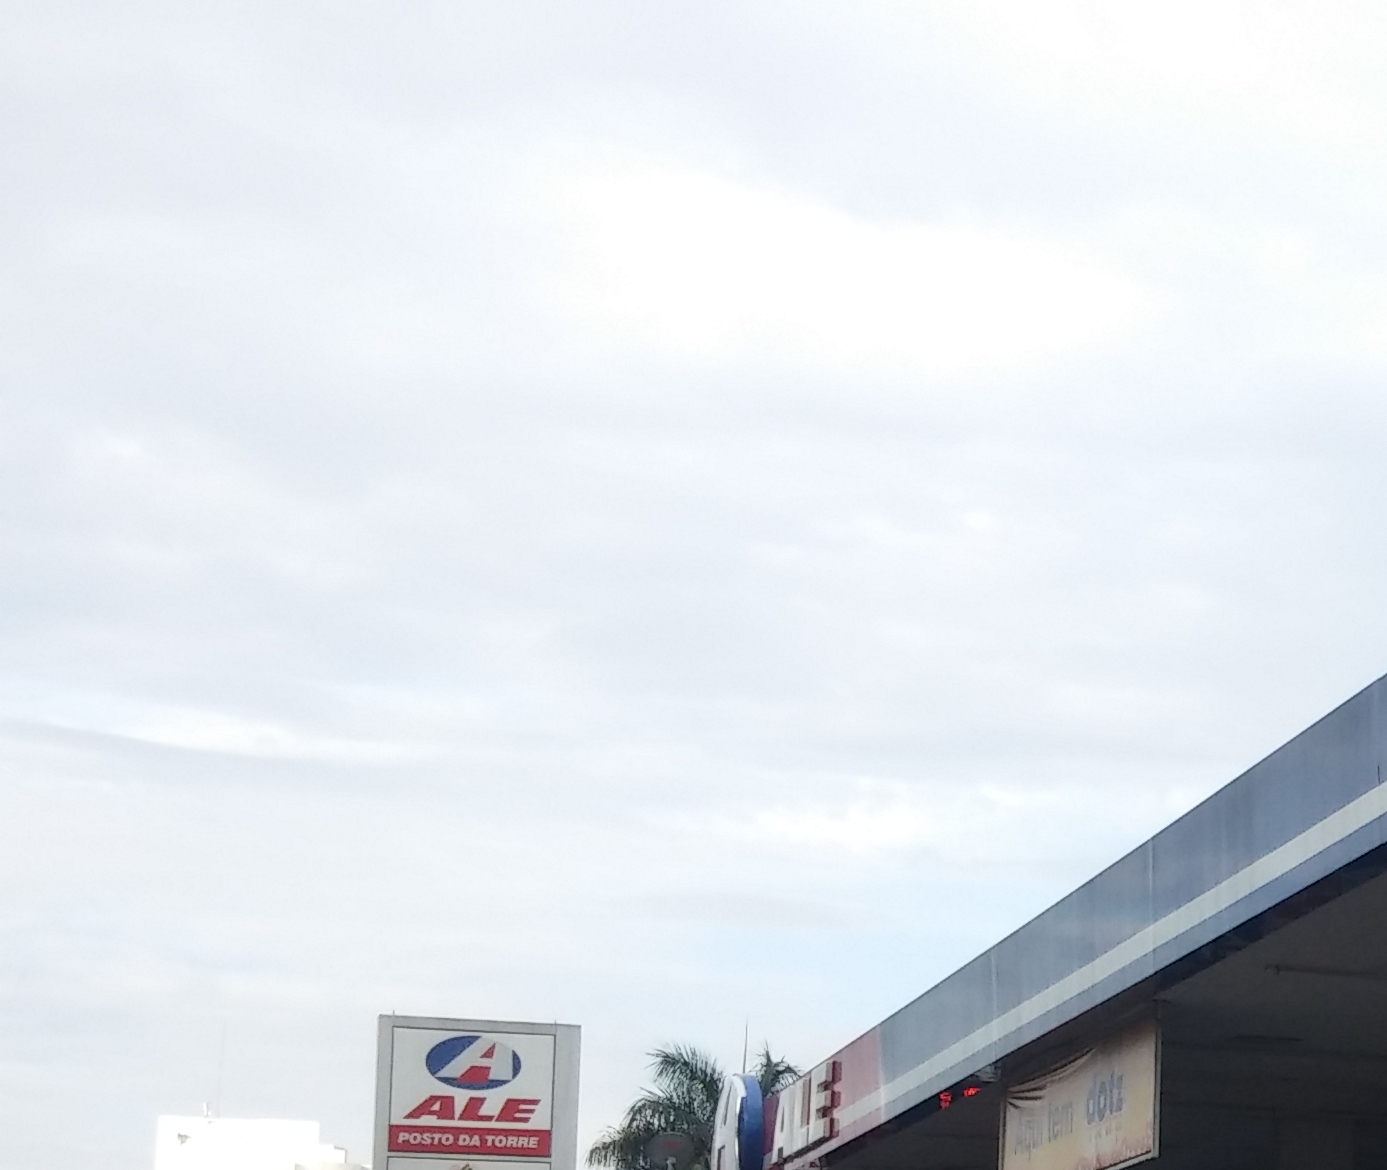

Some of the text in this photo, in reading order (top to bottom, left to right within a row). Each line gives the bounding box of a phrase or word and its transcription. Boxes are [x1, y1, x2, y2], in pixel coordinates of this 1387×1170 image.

[403, 1095, 541, 1123] ALE
[771, 1061, 842, 1164] ALE
[398, 1132, 539, 1149] POSTO DA TORRE
